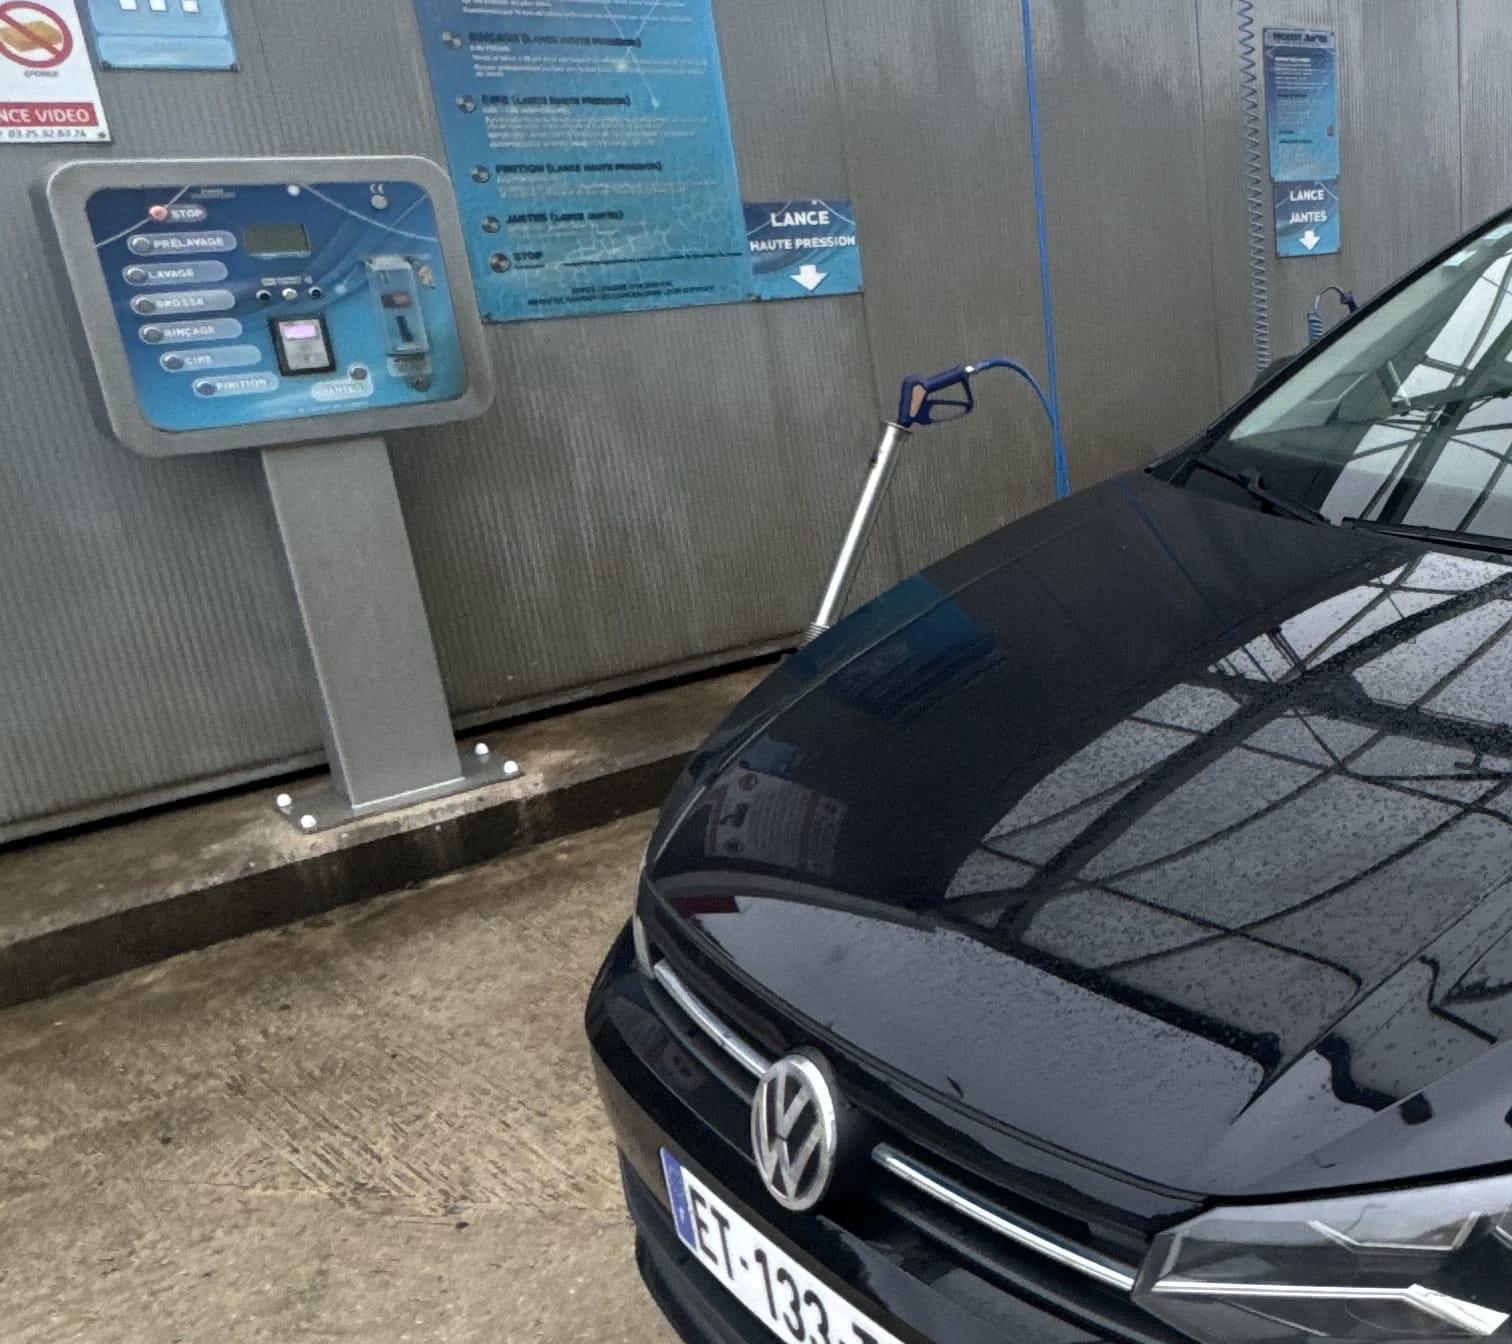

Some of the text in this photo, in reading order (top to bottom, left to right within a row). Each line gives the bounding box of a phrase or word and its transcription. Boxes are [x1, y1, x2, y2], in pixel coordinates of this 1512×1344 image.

[34, 108, 90, 123] VIDEO
[1289, 190, 1325, 202] LANCE
[171, 209, 205, 219] STOP
[770, 210, 831, 228] LANCE
[1288, 210, 1328, 225] JANTES
[749, 235, 857, 252] HAUTE PRESSION
[147, 268, 195, 279] LAVAGE
